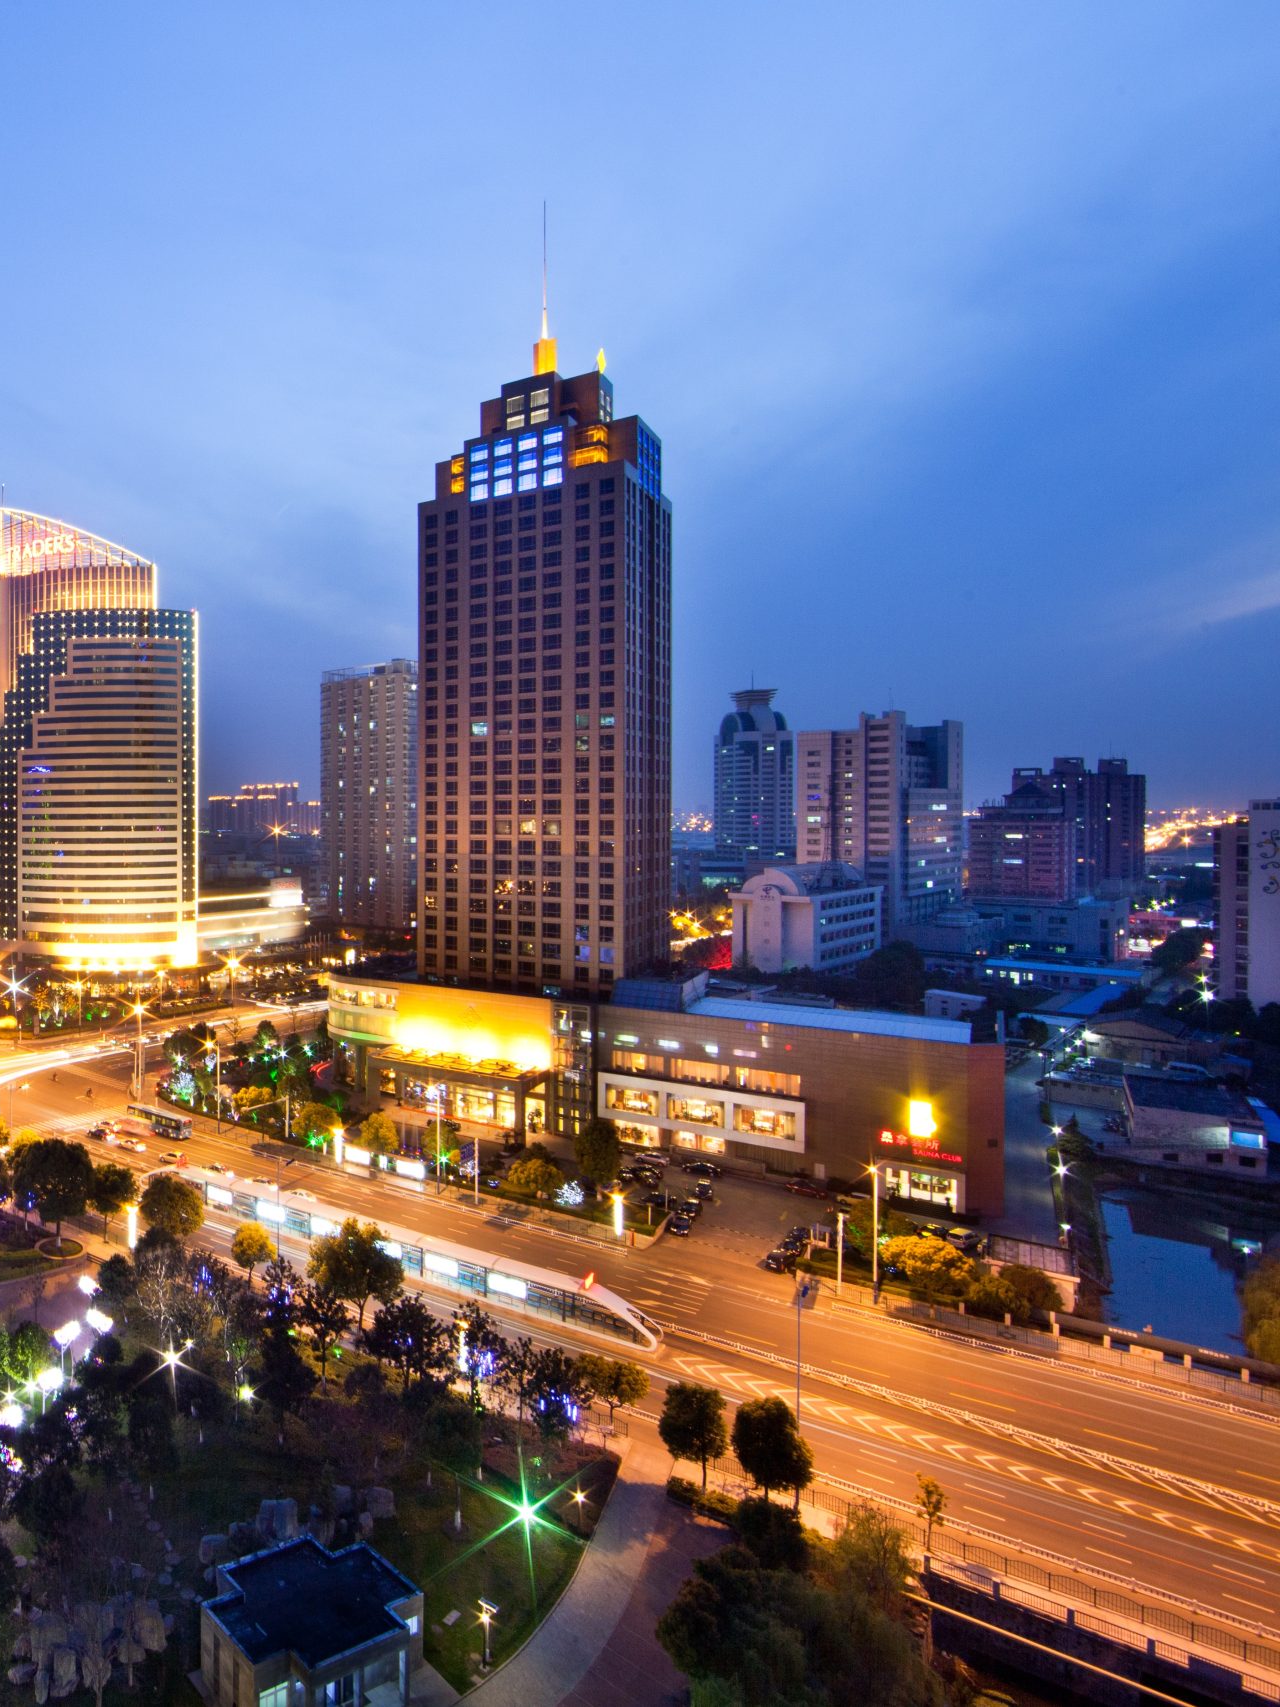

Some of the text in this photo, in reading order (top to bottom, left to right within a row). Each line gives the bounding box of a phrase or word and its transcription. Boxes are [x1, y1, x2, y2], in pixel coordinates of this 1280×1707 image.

[6, 534, 75, 561] TRADERS
[913, 1149, 962, 1162] SAUNA CLUB
